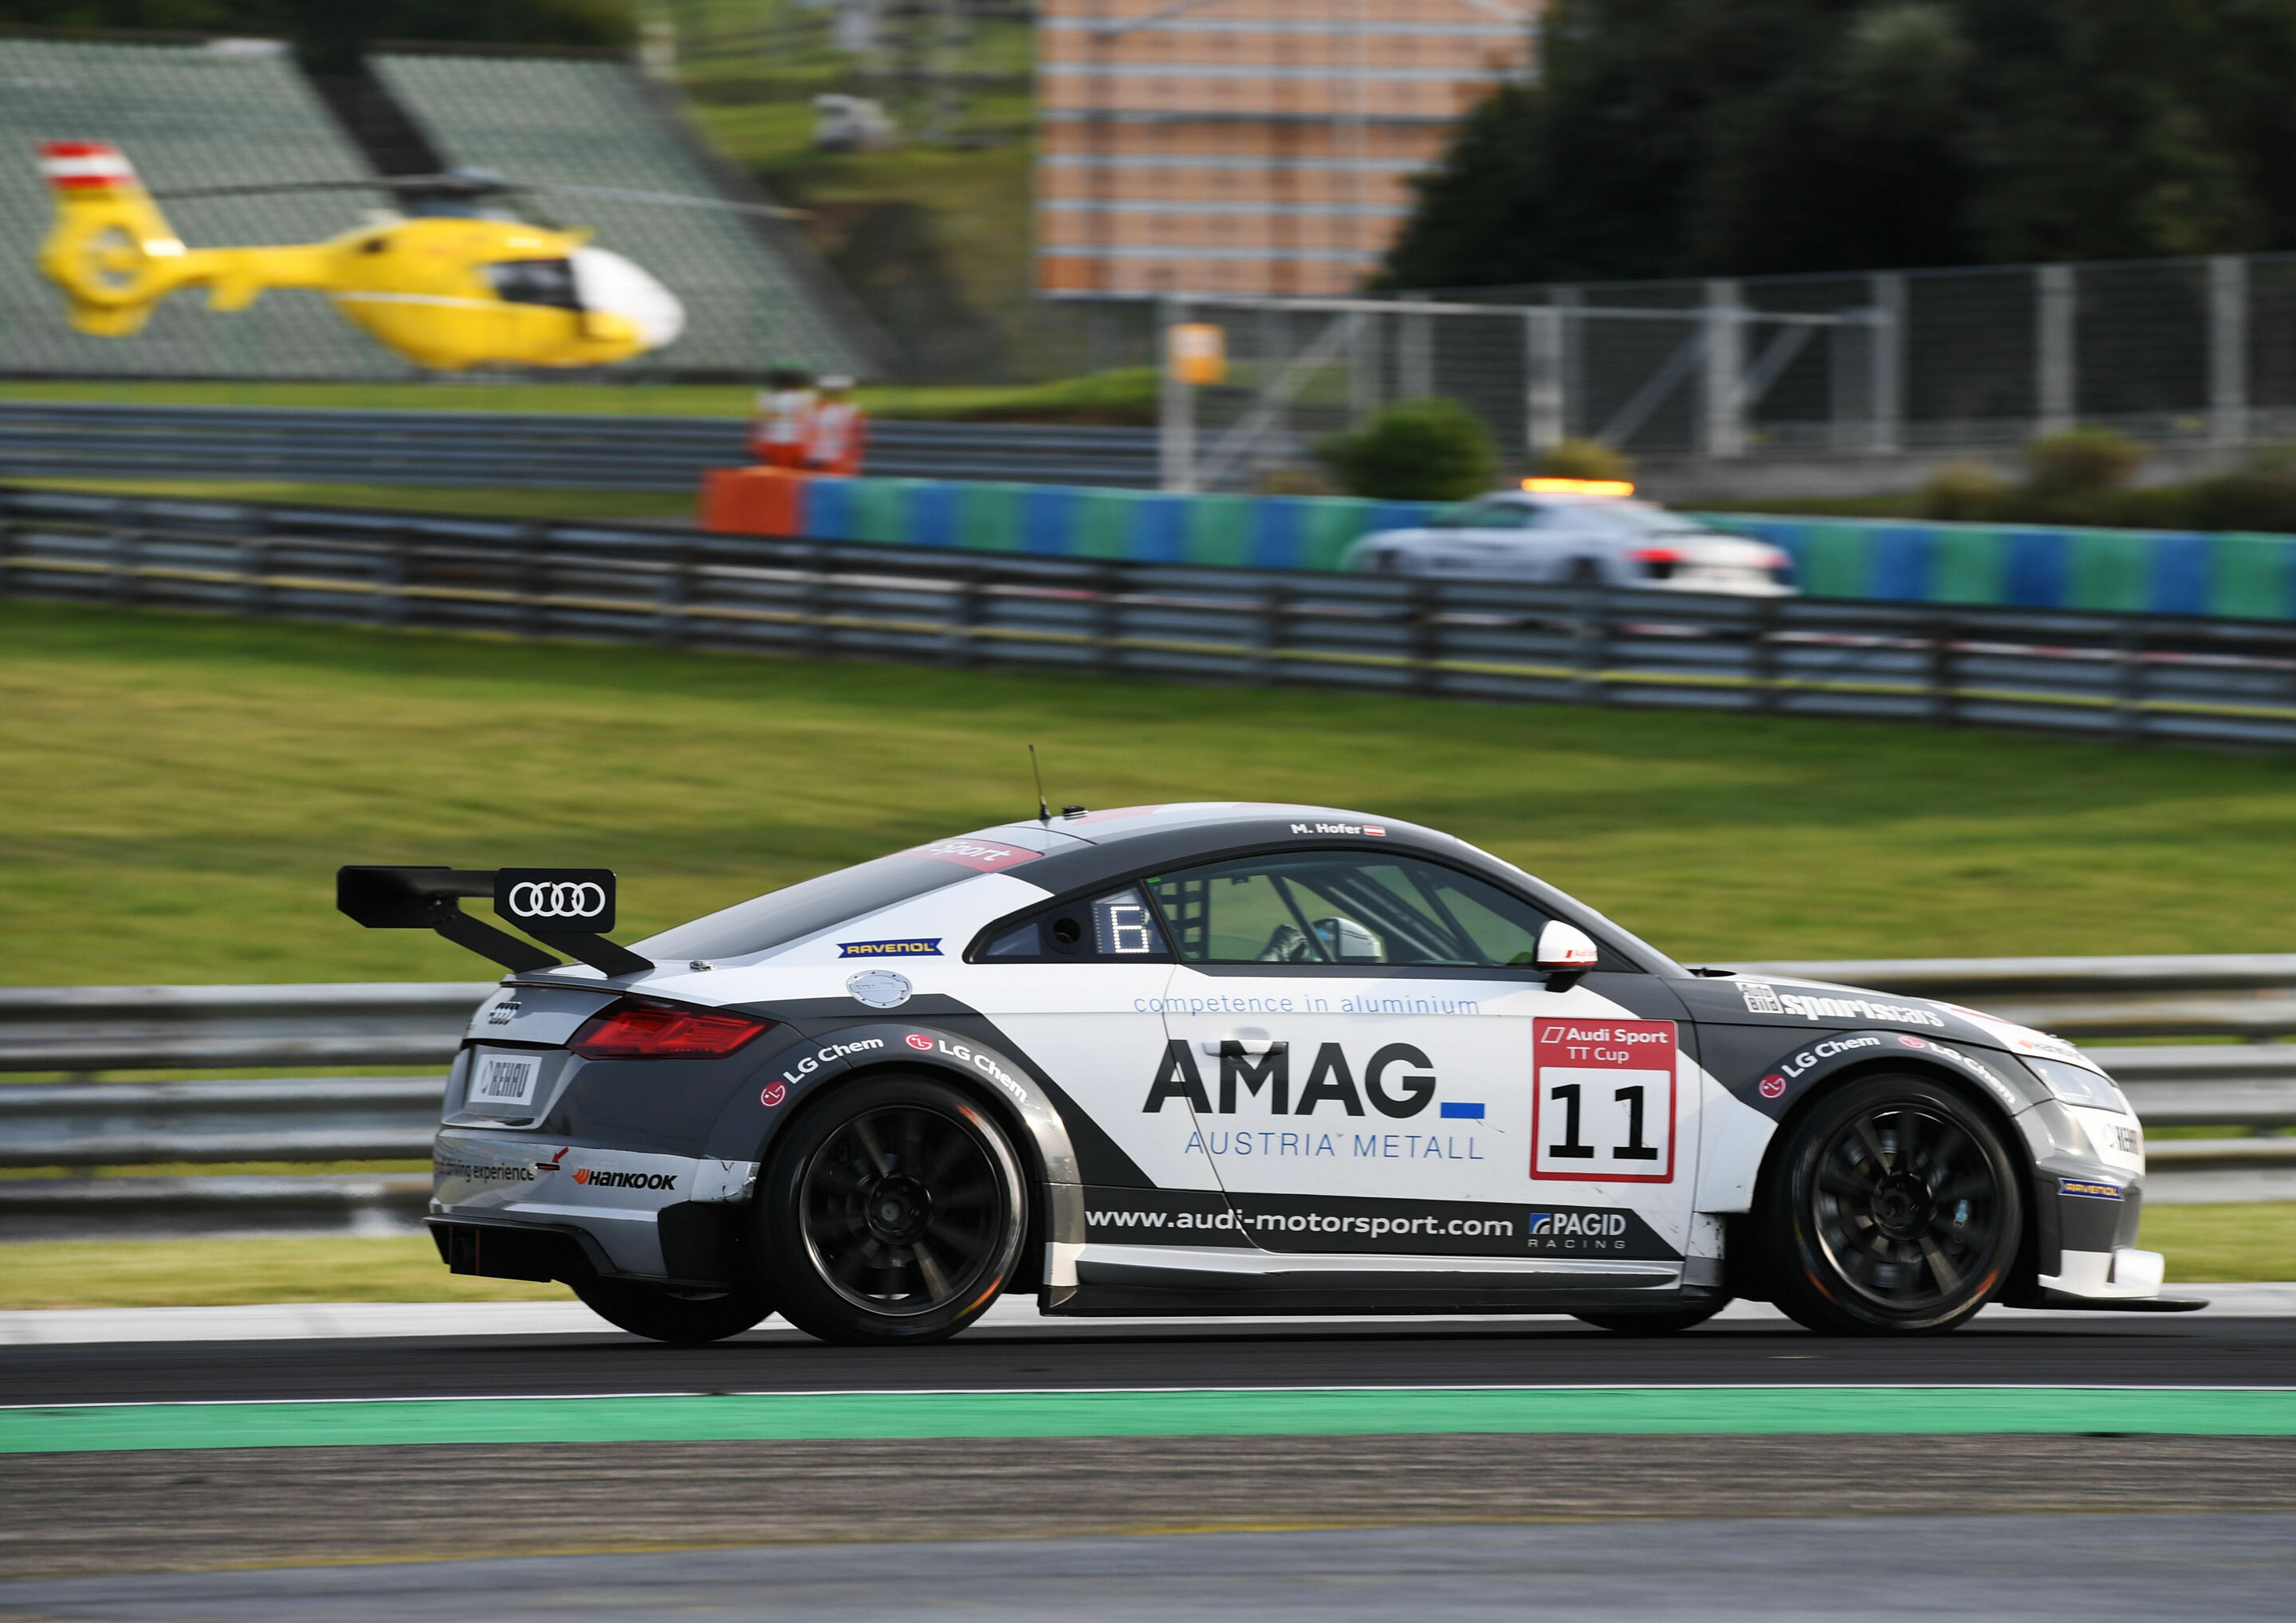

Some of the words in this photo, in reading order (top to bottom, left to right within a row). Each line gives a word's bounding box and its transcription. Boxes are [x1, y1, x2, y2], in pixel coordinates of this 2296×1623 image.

[1290, 823, 1314, 835] M.
[1315, 823, 1362, 835] Hofer
[930, 841, 1011, 862] Sport
[847, 942, 935, 954] RAVENOL
[1134, 995, 1293, 1016] competence
[1304, 994, 1329, 1012] in
[1342, 995, 1480, 1016] aluminium
[1779, 993, 1945, 1028] sportscars
[1566, 1028, 1610, 1042] Audi
[1614, 1028, 1669, 1045] Sport
[783, 1057, 820, 1084] LG
[818, 1038, 884, 1062] Chem
[1566, 1046, 1590, 1059] TT
[1594, 1047, 1630, 1063] Cup
[1780, 1051, 1818, 1078] LG
[1814, 1036, 1881, 1058] Chem
[488, 1061, 532, 1098] REHAU
[938, 1039, 971, 1061] LG
[973, 1054, 1028, 1103] Chem
[1142, 1039, 1437, 1118] AMAG
[1928, 1042, 1962, 1061] LG
[1964, 1056, 2015, 1104] Chem
[1549, 1083, 1658, 1161] 11
[1185, 1130, 1336, 1157] AUSTRIA
[1354, 1134, 1484, 1160] METALL
[1086, 1208, 1513, 1239] www.audi-motorsport.com
[1553, 1212, 1627, 1236] PAGID
[1527, 1239, 1627, 1250] RACING
